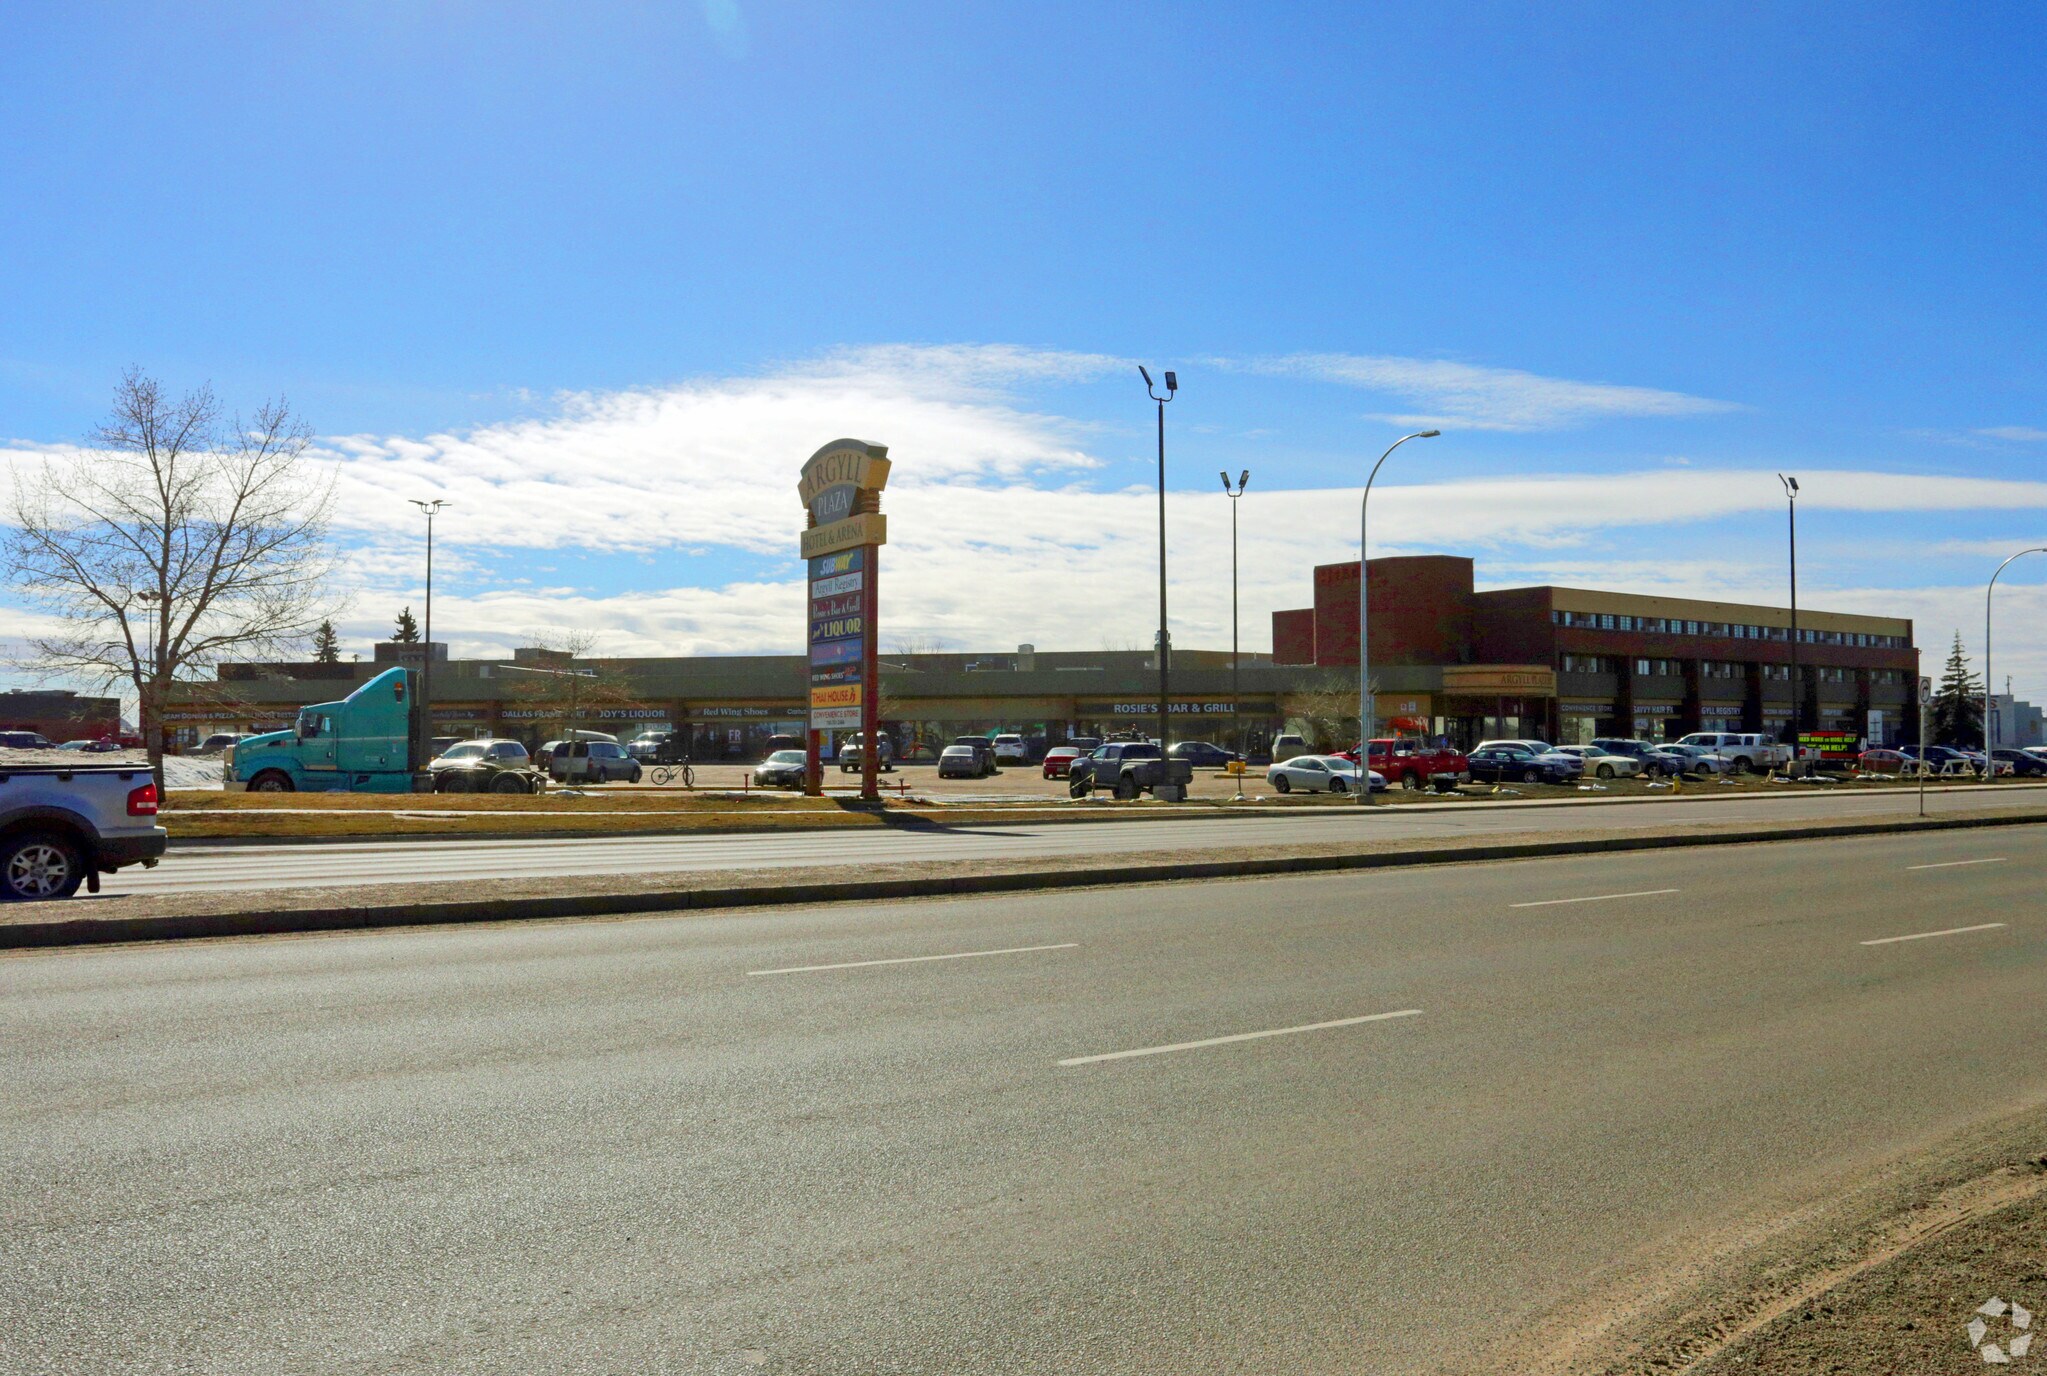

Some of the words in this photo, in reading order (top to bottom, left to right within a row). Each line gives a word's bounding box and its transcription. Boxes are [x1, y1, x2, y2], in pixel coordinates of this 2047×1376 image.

[806, 453, 861, 500] ARGYLL
[818, 489, 848, 516] PLAZA
[803, 532, 828, 552] HOTEL
[828, 529, 835, 545] &
[836, 521, 864, 543] ARENA
[820, 552, 855, 576] SUBWAY
[824, 617, 862, 638] LIQUOR
[812, 692, 827, 704] THAI
[827, 690, 849, 703] HOUSE
[501, 710, 533, 718] DALLAS
[599, 709, 627, 718] JOY'S
[629, 710, 666, 718] LIQUOR
[703, 707, 719, 716] Red
[720, 707, 742, 716] Wing
[744, 707, 769, 716] Shoes
[814, 710, 843, 719] CONVENIENCE
[844, 709, 859, 718] STORE
[1114, 703, 1158, 713] ROSIE'S
[1167, 703, 1189, 713] BAR
[1191, 703, 1201, 713] &
[1203, 703, 1235, 713] GRILL
[1717, 706, 1742, 715] REGISTRY
[728, 729, 741, 741] FR
